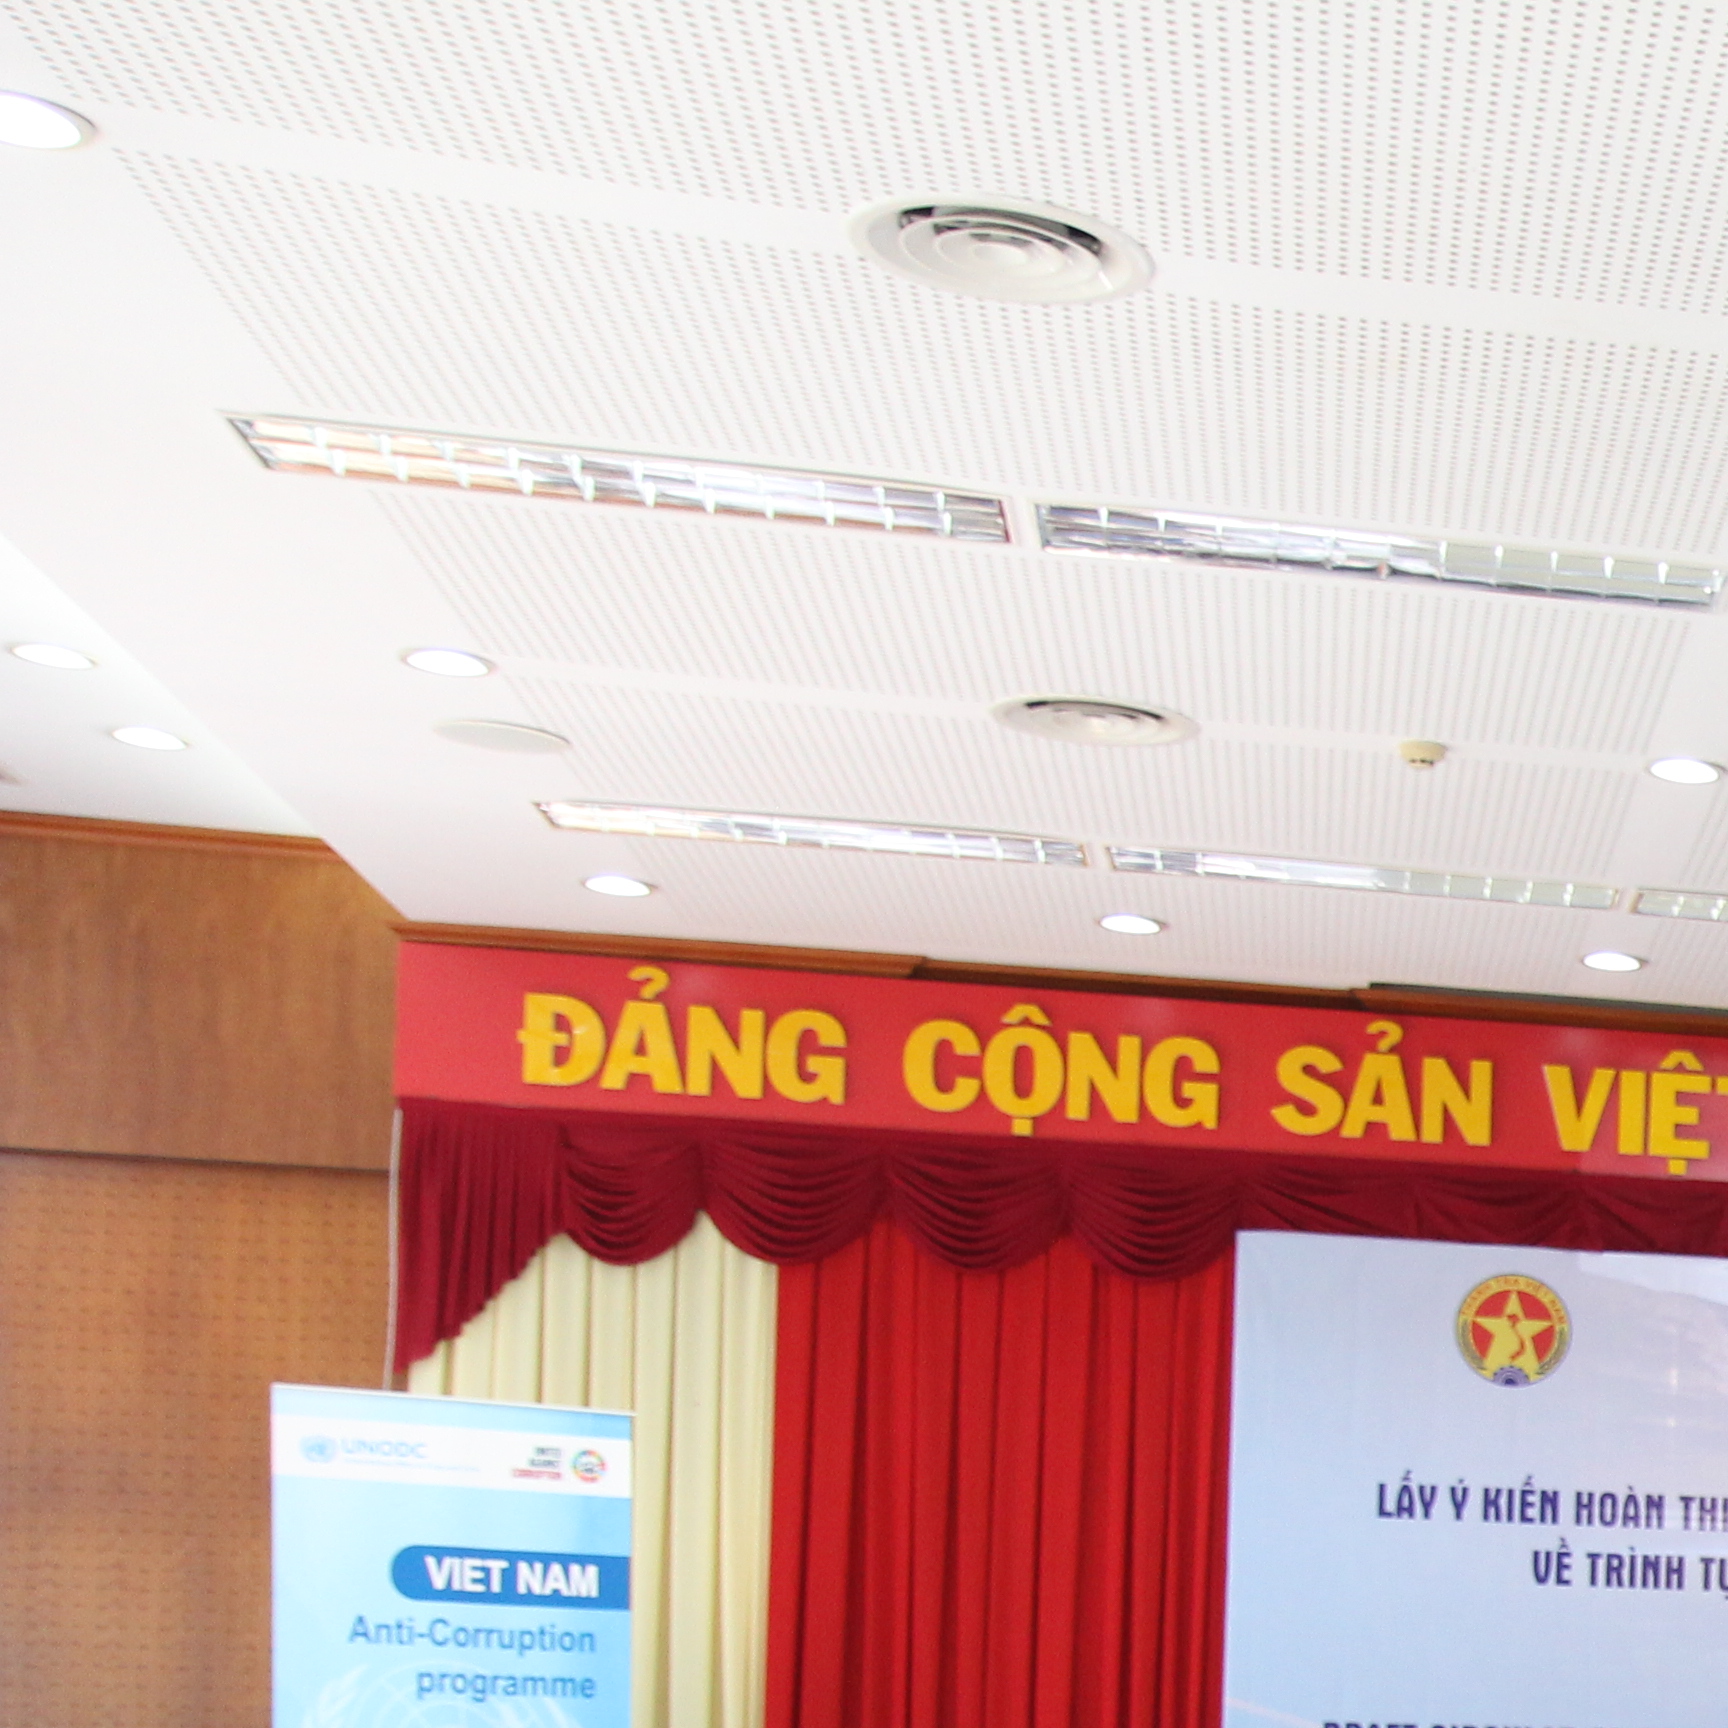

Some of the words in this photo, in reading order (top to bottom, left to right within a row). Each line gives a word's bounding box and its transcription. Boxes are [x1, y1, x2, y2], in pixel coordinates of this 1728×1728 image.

[516, 965, 847, 1104] ĐẢNG
[903, 1005, 1220, 1136] CỘNG
[1270, 1022, 1494, 1147] SẢN
[1378, 1469, 1439, 1520] LẤY
[1450, 1478, 1470, 1521] Ý
[1482, 1472, 1561, 1527] KIẾN
[1575, 1487, 1664, 1531] HOÀN
[424, 1555, 509, 1595] VIET
[516, 1562, 600, 1599] NAM
[1532, 1537, 1573, 1587] VỀ
[1586, 1544, 1686, 1593] TRÌNH
[348, 1614, 597, 1658] Anti-Corruption
[416, 1667, 597, 1704] programme
